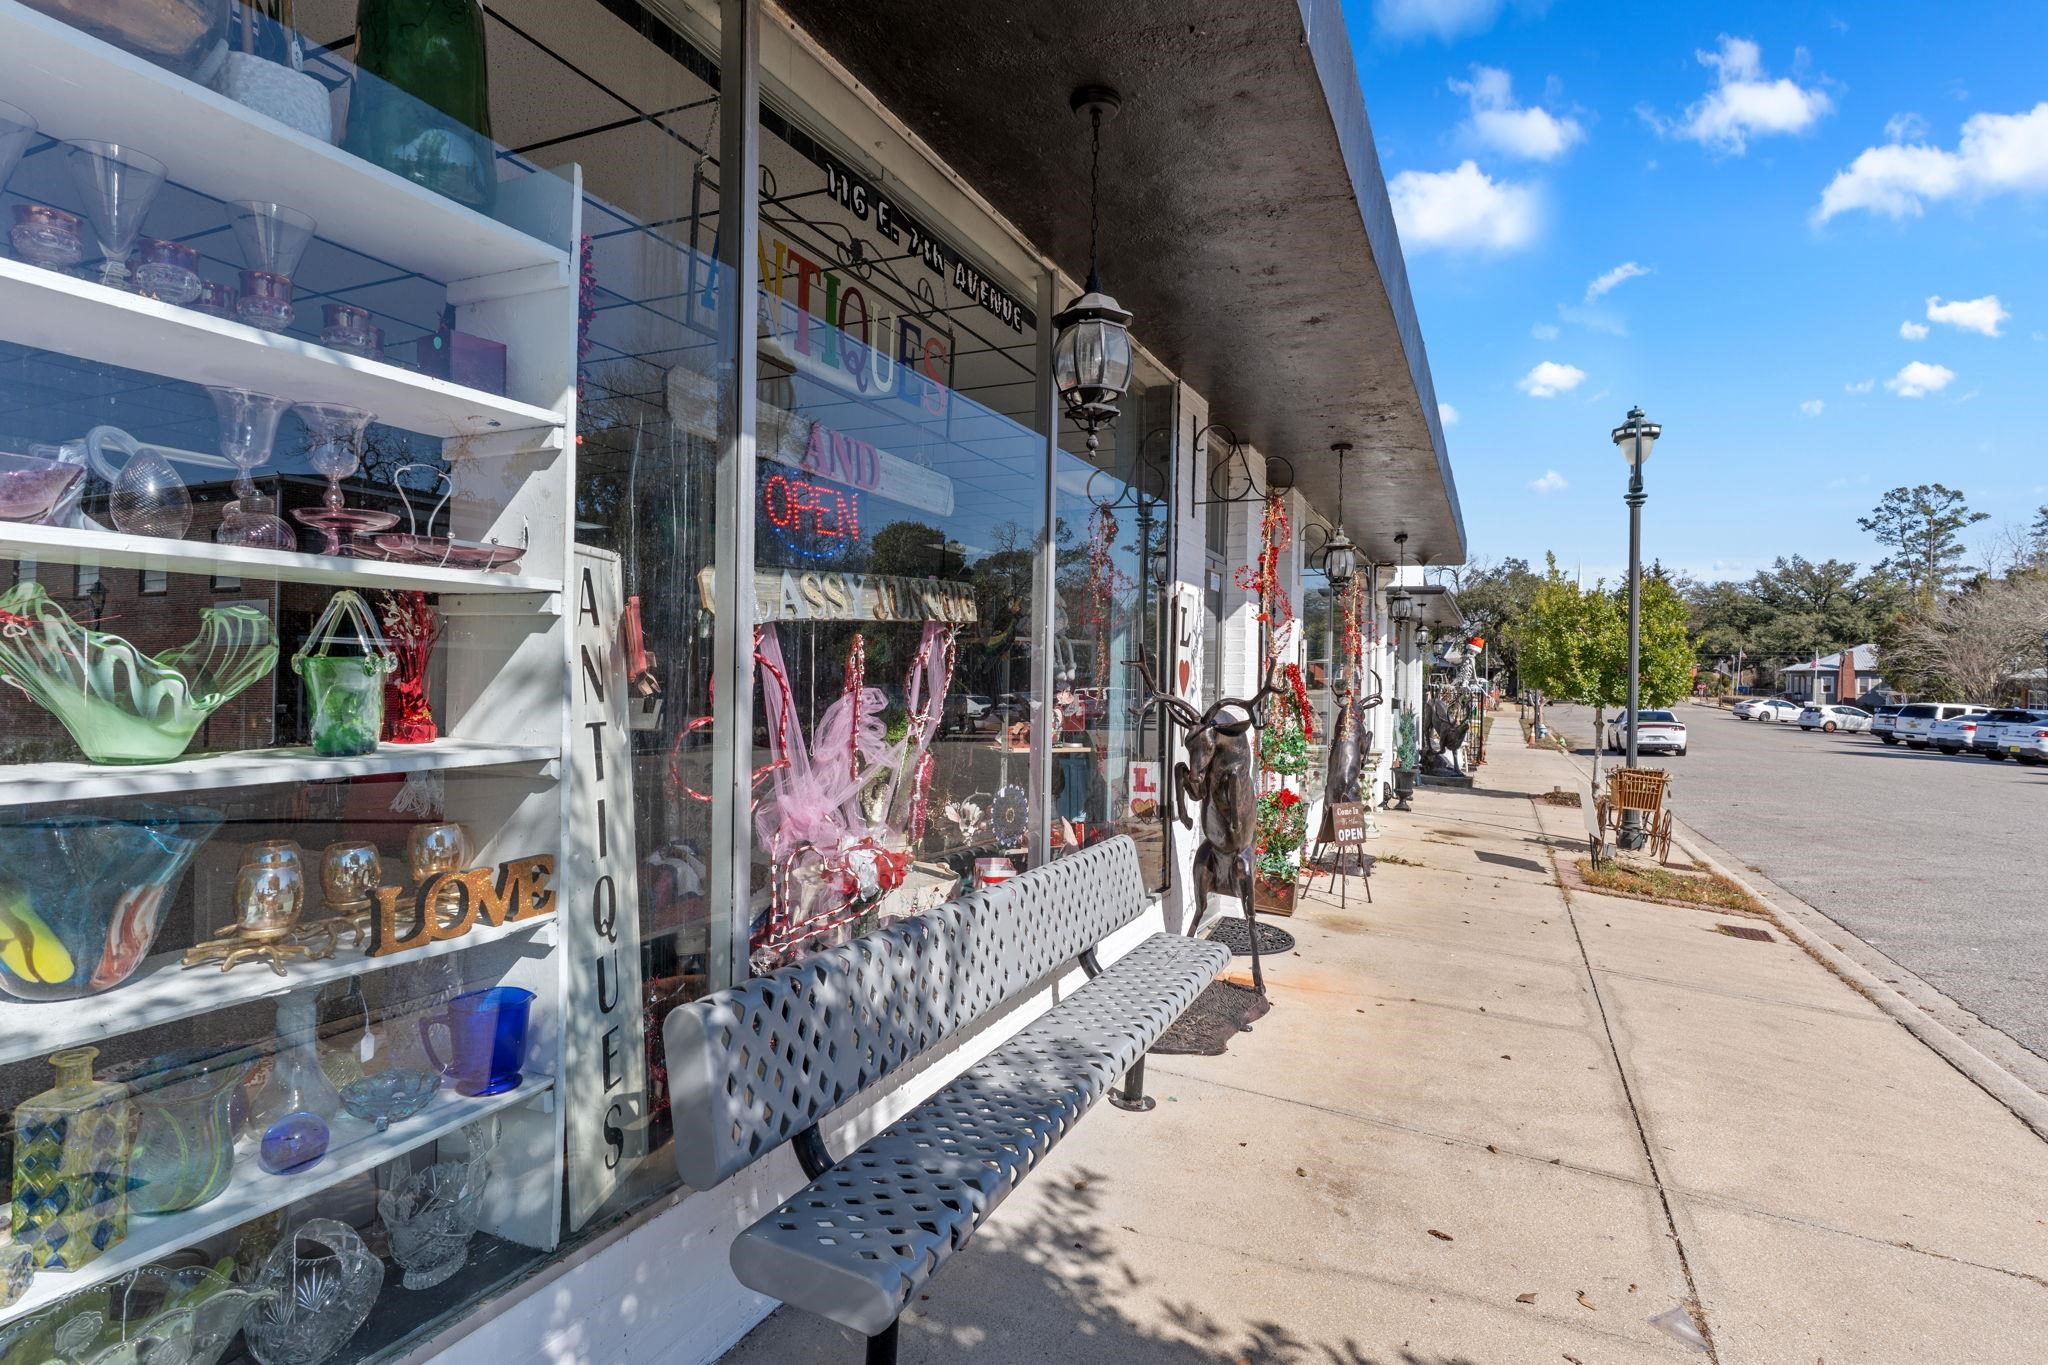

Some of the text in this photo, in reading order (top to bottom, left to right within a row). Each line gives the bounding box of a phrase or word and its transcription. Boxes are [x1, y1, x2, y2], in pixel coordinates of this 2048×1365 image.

[826, 163, 867, 215] 116
[954, 261, 1022, 330] AVENUE
[799, 421, 881, 492] AND
[764, 474, 860, 541] OPEN
[711, 568, 867, 622] ASSY
[578, 567, 624, 1170] ANTIQUES
[1338, 827, 1364, 842] OPEN
[365, 853, 556, 957] LOVE
